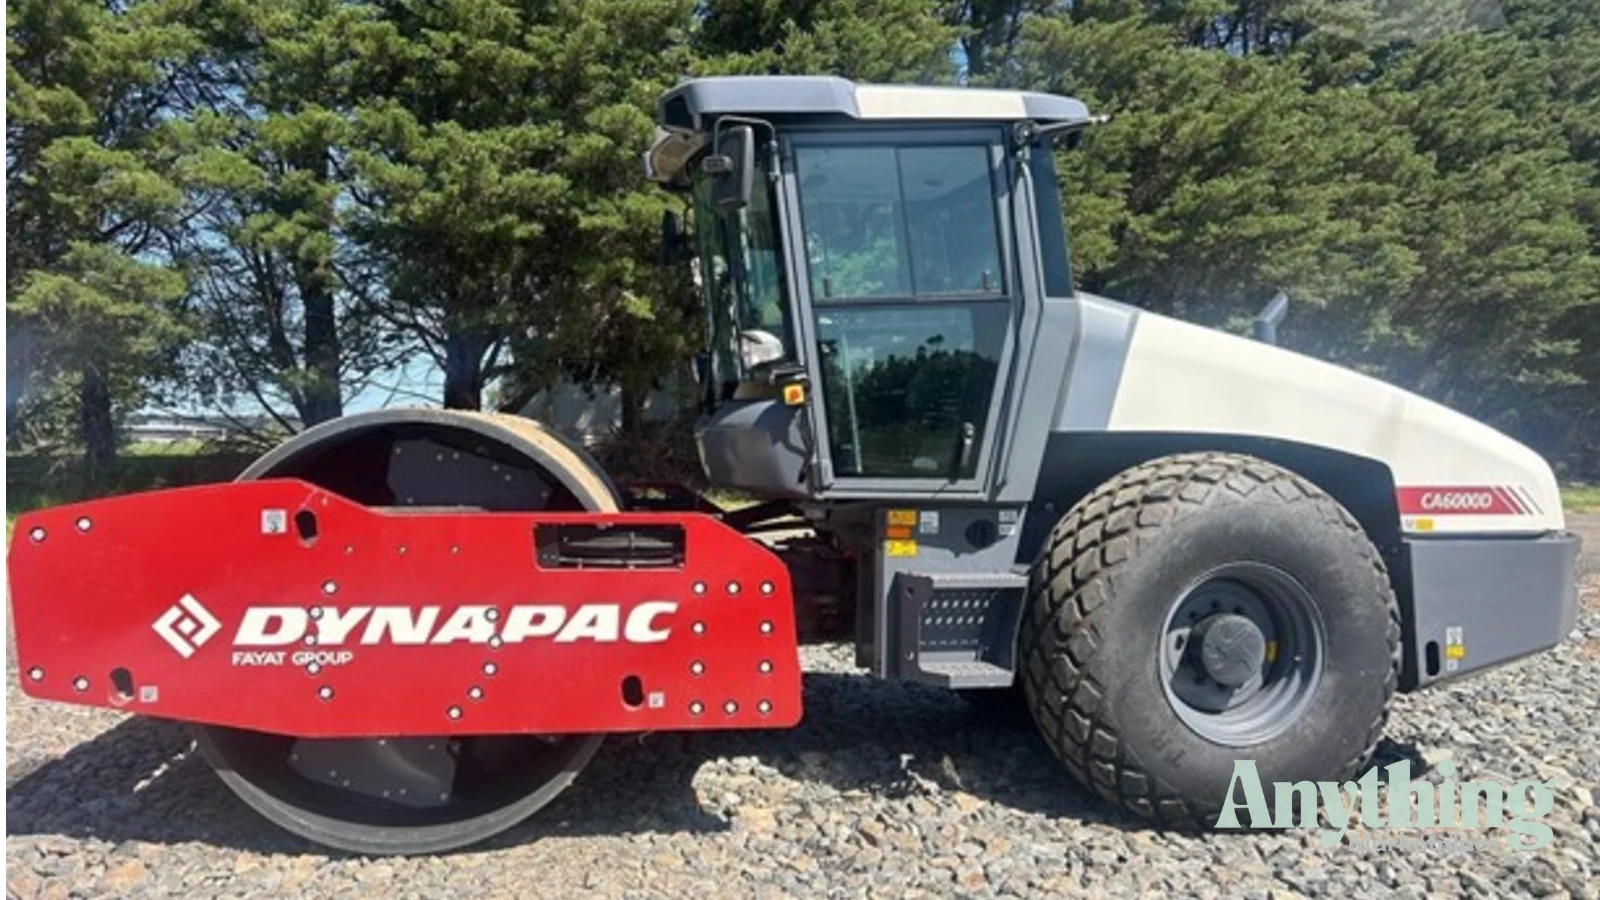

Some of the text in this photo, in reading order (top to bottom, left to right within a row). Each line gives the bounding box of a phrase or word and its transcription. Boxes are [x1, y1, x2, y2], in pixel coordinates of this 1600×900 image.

[1420, 491, 1493, 510] CA6000D
[232, 601, 679, 645] DYNAPAC
[232, 651, 354, 666] FAYAT GROUP
